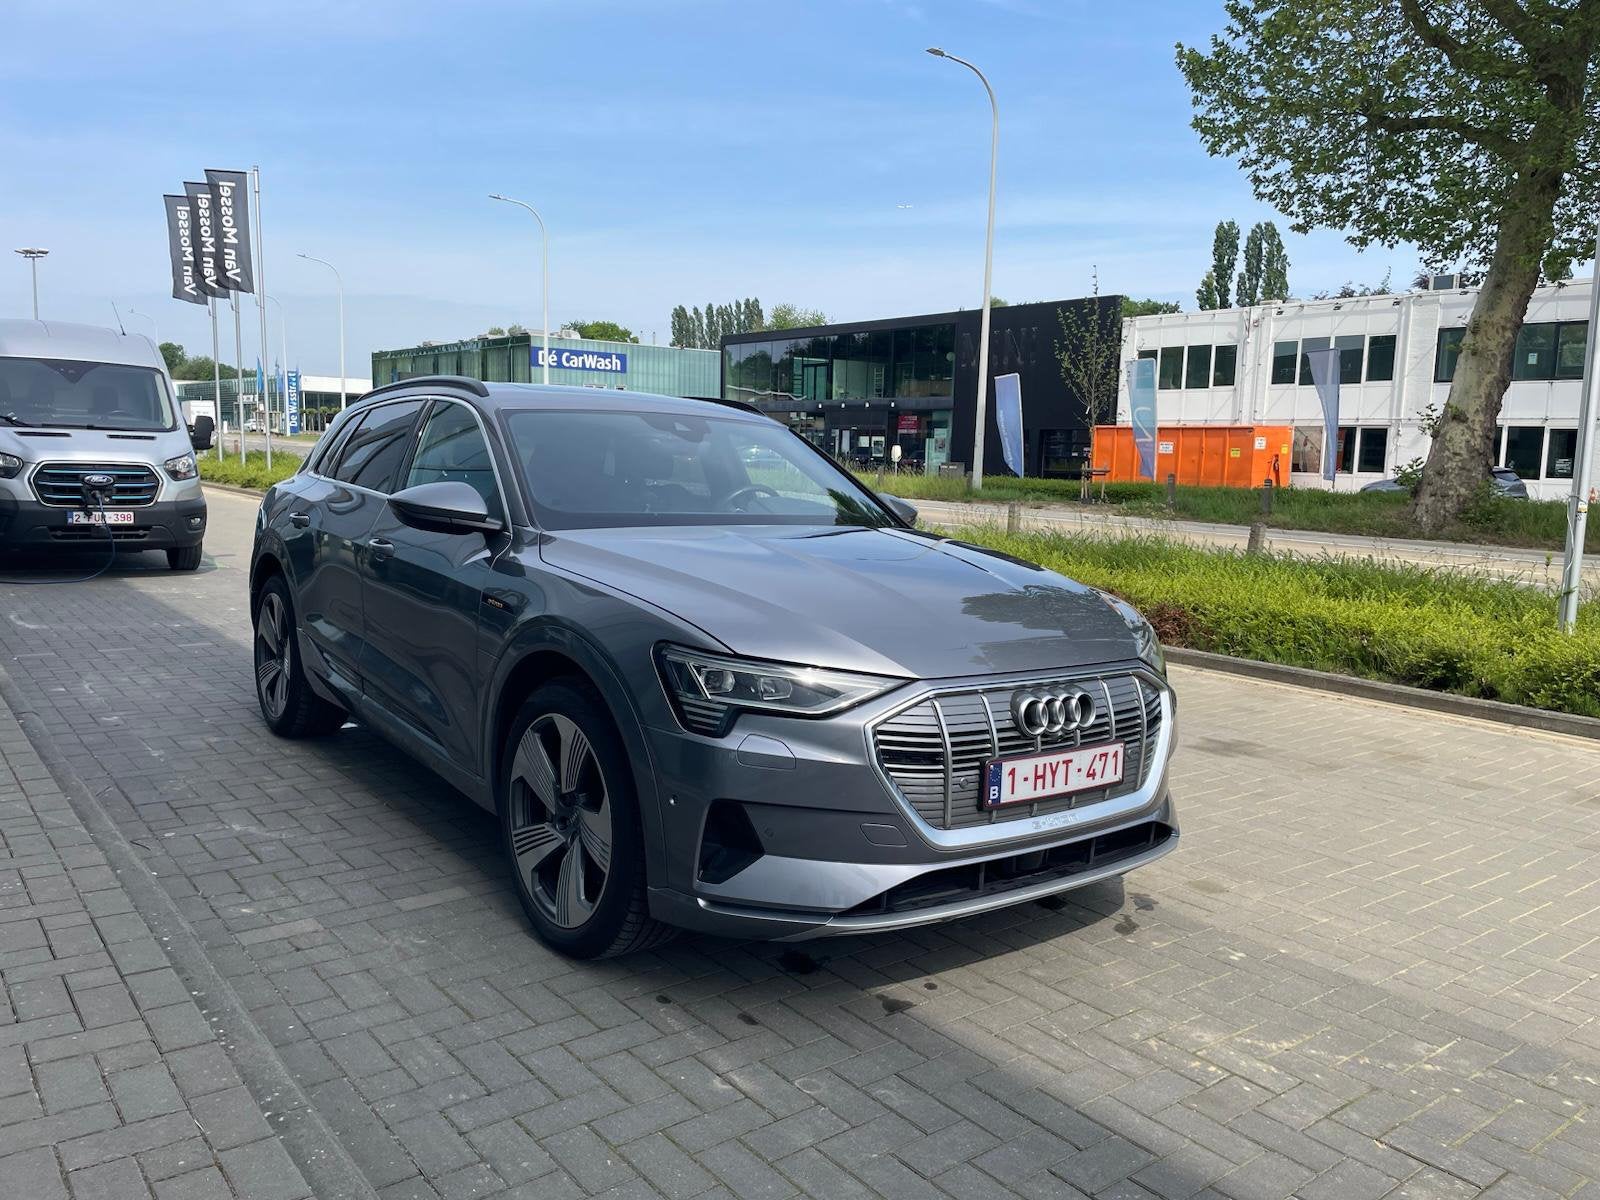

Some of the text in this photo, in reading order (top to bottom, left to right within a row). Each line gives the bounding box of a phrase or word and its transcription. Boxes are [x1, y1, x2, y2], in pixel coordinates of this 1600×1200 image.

[537, 350, 622, 371] Dé CarWash
[289, 414, 298, 427] De
[1008, 750, 1119, 795] 1-HYT-471
[989, 786, 999, 799] B
